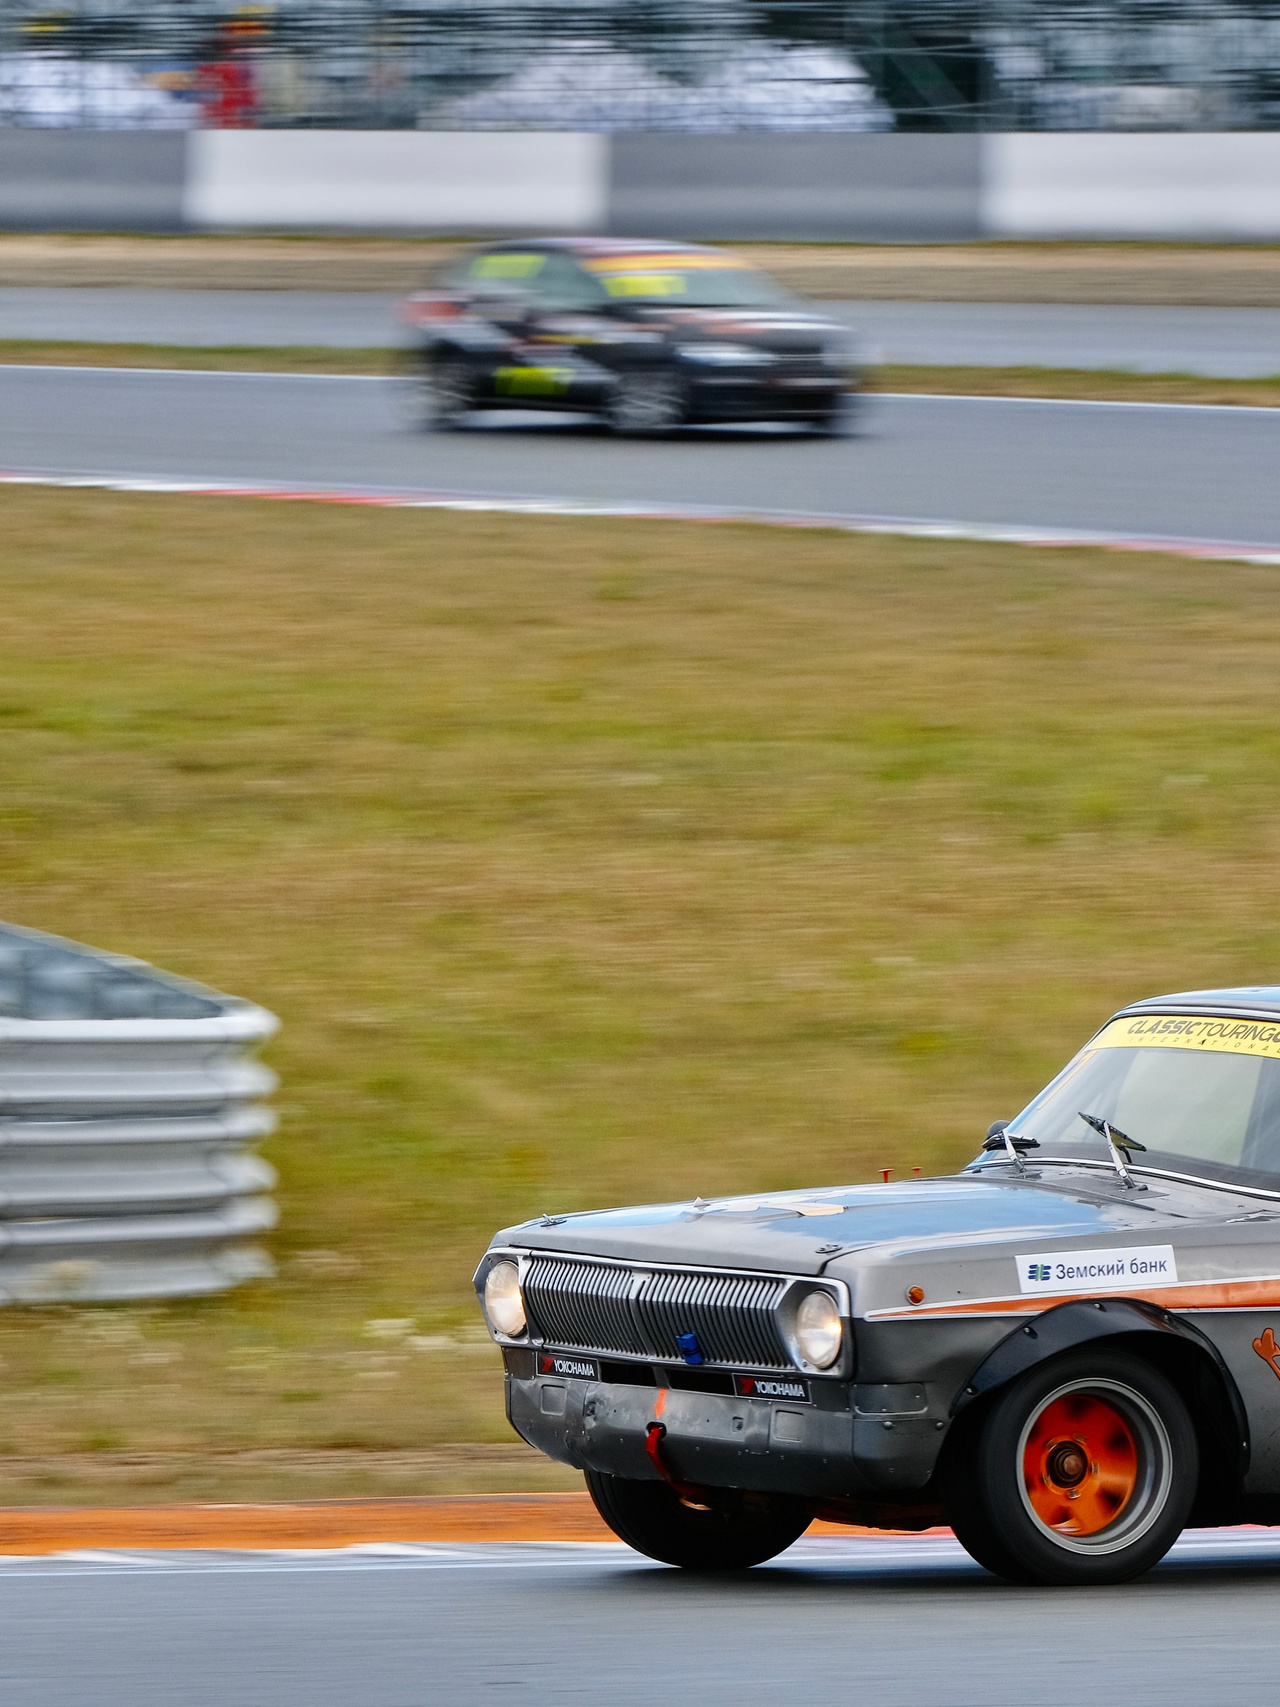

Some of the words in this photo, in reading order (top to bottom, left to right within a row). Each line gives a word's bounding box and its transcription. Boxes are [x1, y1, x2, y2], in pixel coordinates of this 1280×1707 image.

[1055, 1259, 1125, 1280] Земский
[1129, 1257, 1168, 1274] банк
[553, 1359, 595, 1377] YOKOHAMA
[754, 1380, 806, 1397] YOKOHAMA
